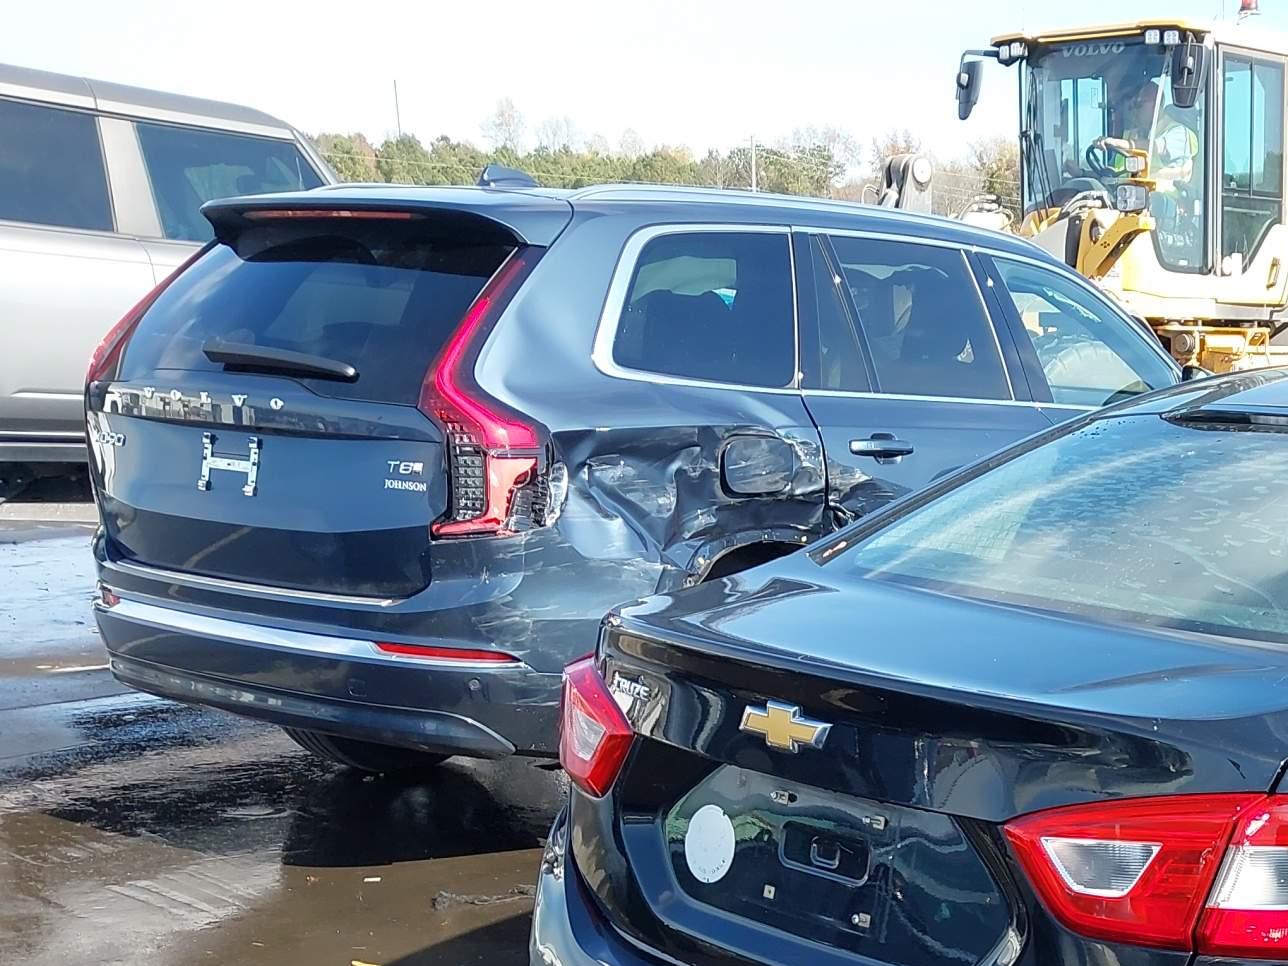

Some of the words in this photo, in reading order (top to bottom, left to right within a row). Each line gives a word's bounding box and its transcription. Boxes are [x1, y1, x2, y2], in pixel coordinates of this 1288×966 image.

[1062, 41, 1125, 58] VOLVO
[143, 386, 285, 410] VOLVO
[384, 478, 427, 492] JOHNSON
[613, 676, 650, 702] CRUZE
